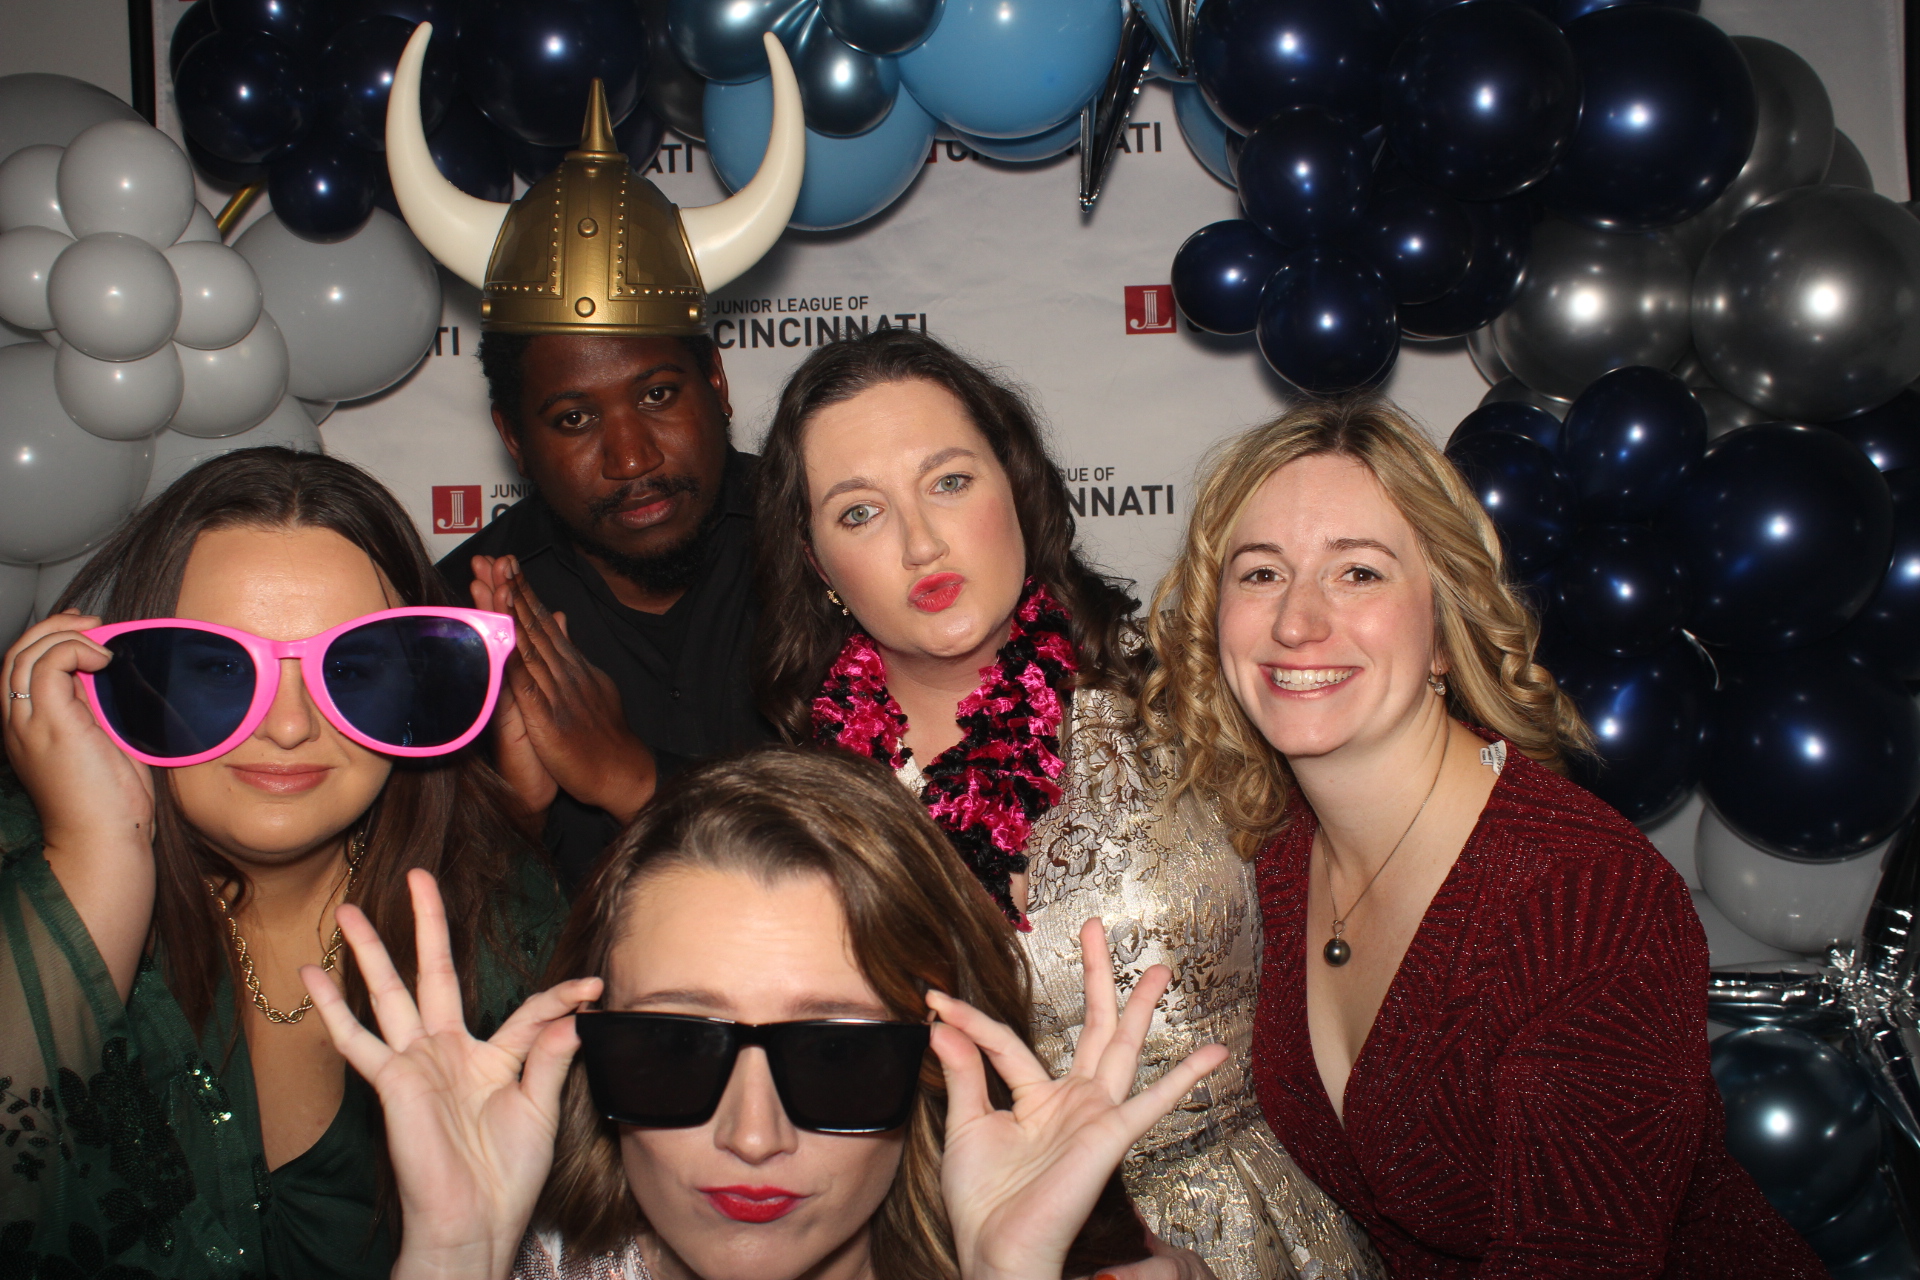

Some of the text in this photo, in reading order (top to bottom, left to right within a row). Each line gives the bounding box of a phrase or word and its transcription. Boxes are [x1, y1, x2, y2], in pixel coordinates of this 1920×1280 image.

[712, 296, 869, 315] JUNIOR LEAGUE OF
[713, 313, 927, 349] CINCINNATI
[1094, 466, 1115, 481] OF
[490, 484, 531, 498] JUNI
